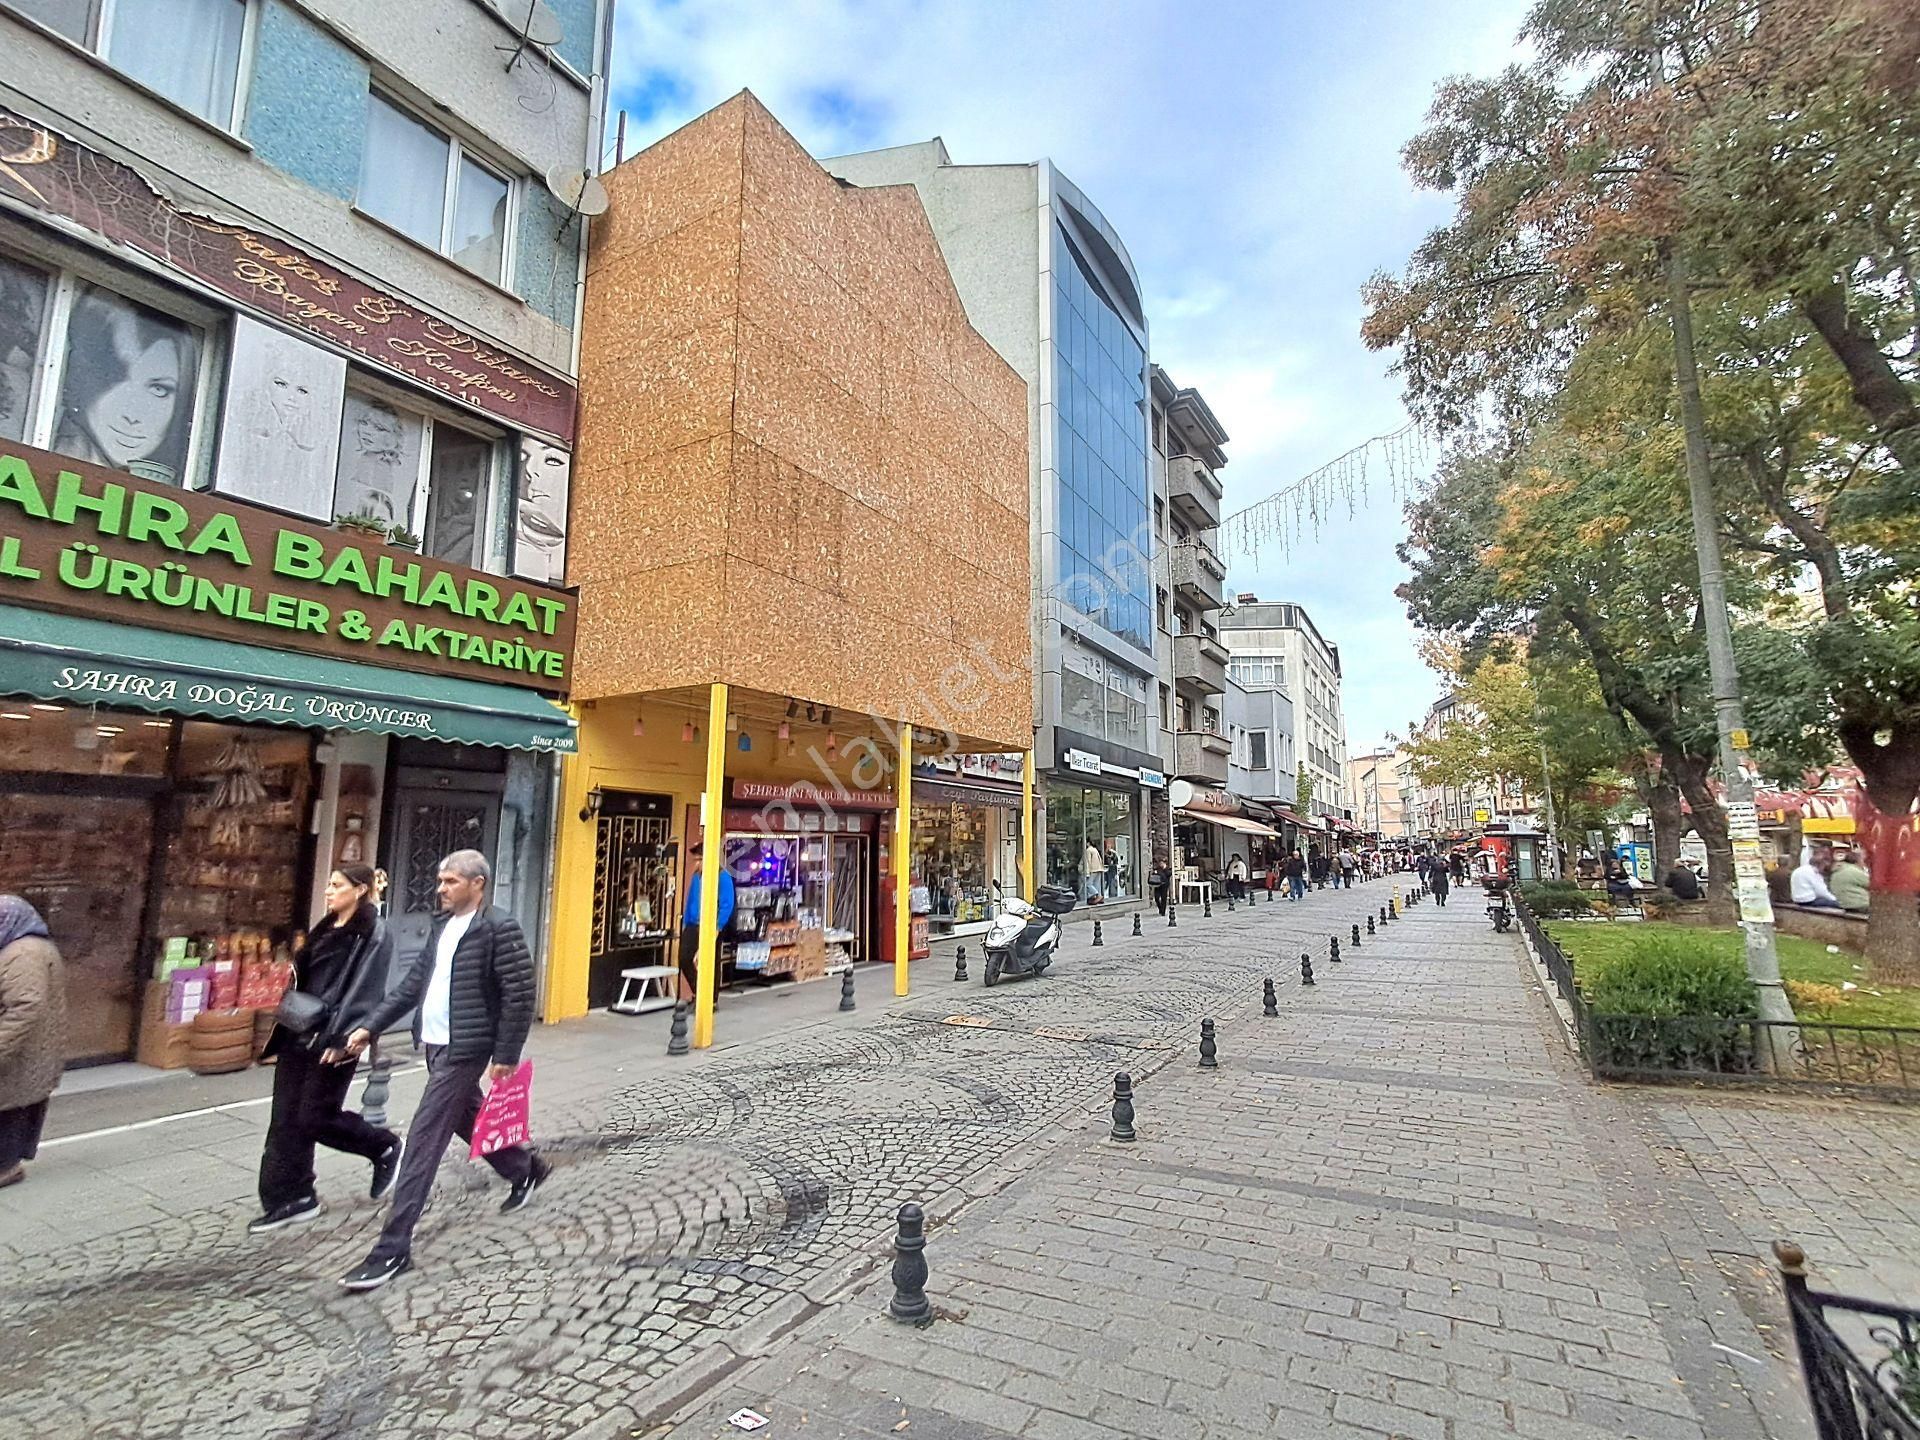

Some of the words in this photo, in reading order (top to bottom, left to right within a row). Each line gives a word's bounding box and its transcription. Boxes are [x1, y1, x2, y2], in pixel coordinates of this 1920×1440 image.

[233, 257, 368, 335] Bayan
[387, 336, 518, 402] Kuaförü
[354, 296, 412, 324] &
[58, 541, 330, 634] ÜRÜNLER
[338, 610, 372, 642] &
[377, 618, 565, 678] AKTARİYE
[273, 528, 566, 636] BAHARAT
[53, 667, 178, 701] SAHRA
[187, 682, 295, 714] DOĞAL
[305, 695, 437, 732] ÜRÜNLER
